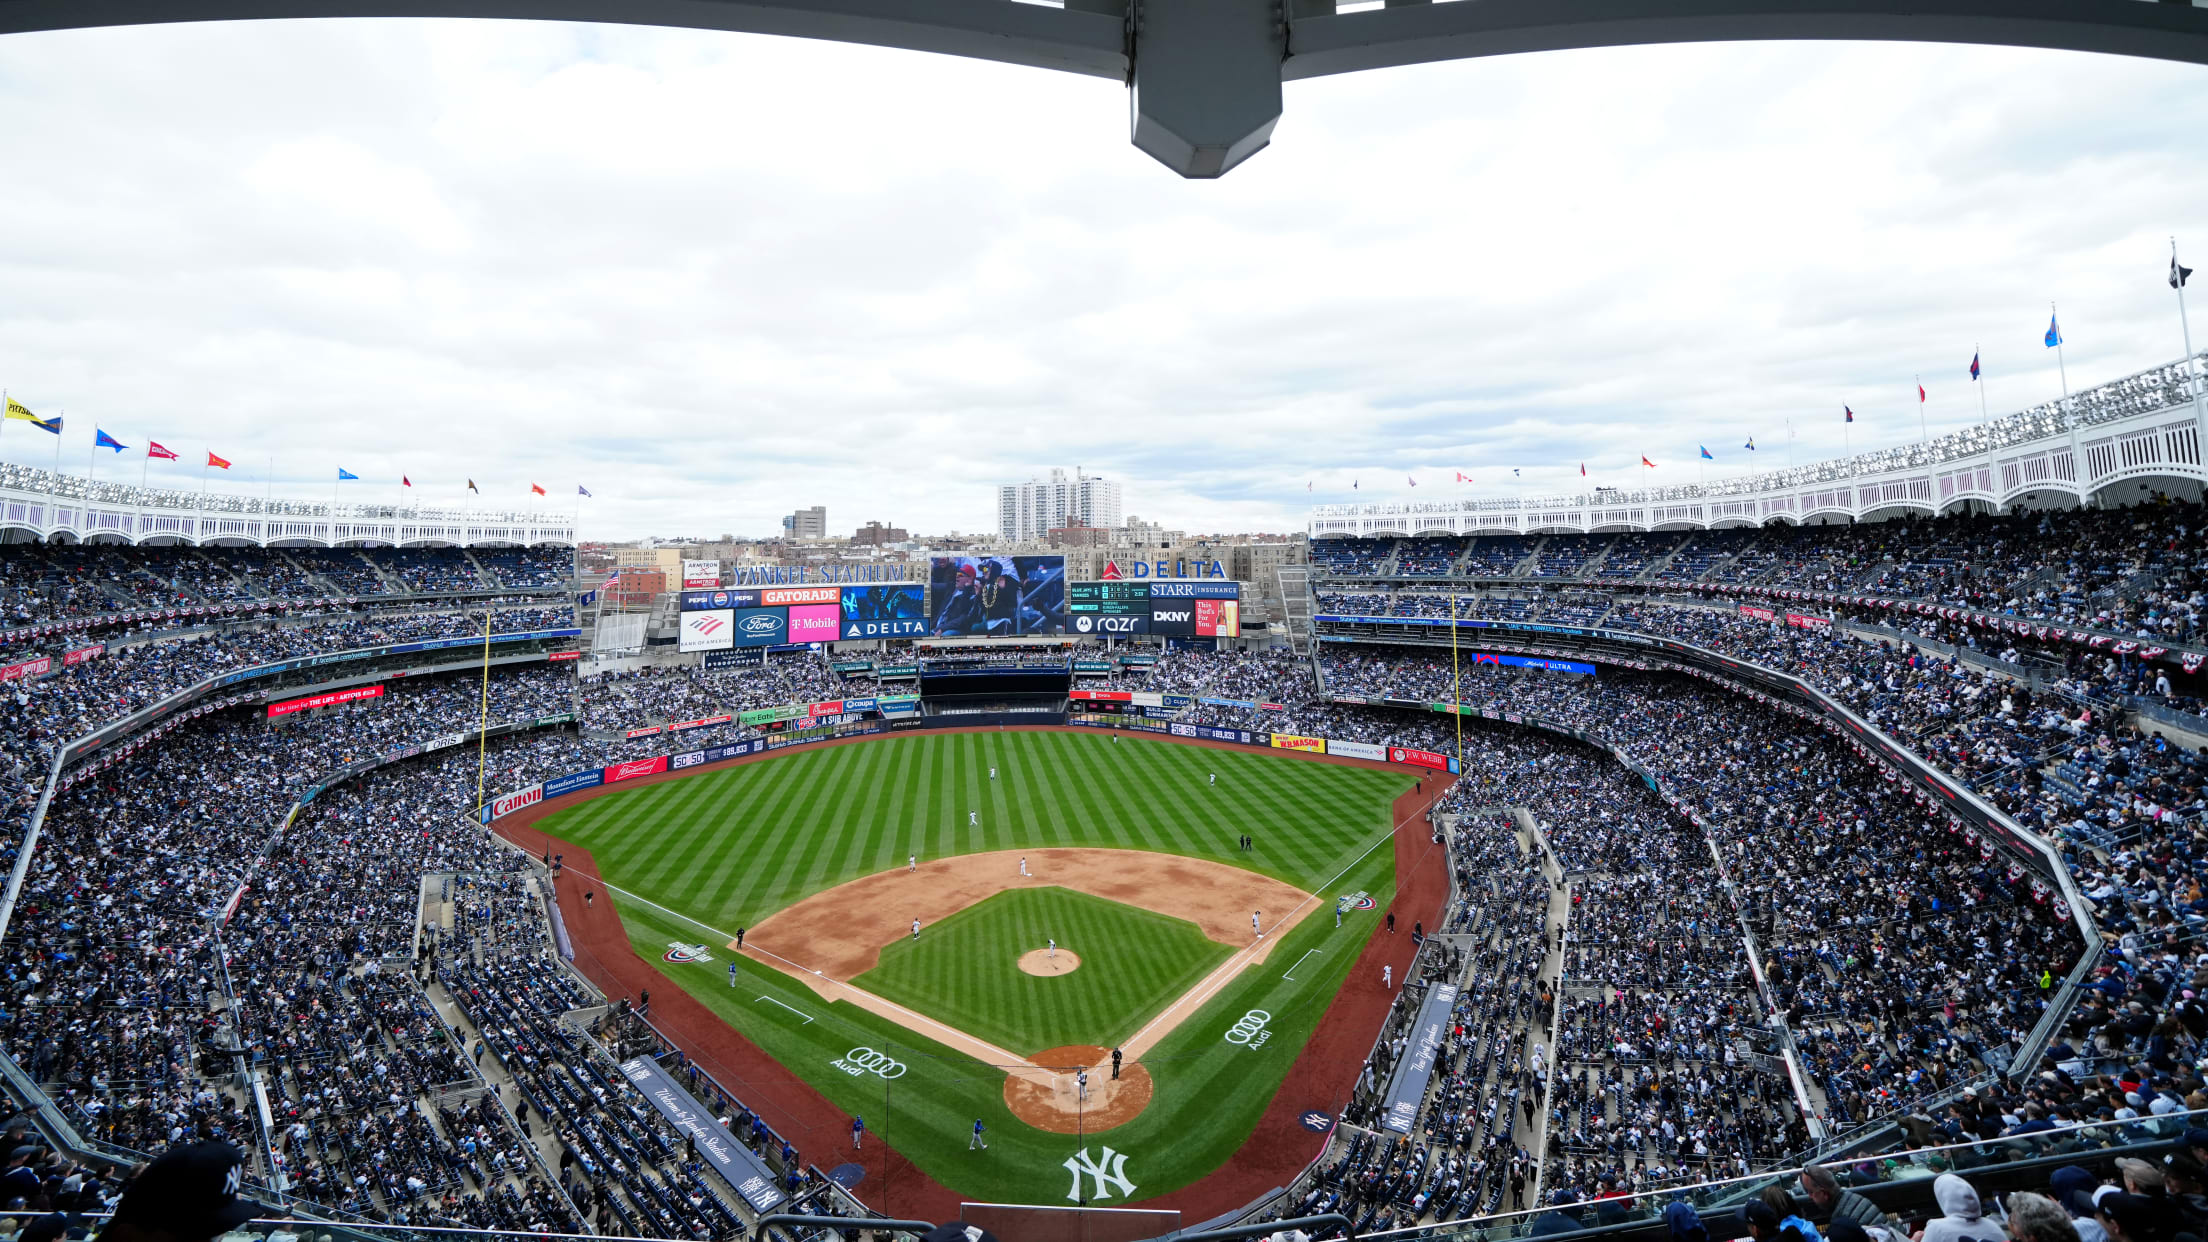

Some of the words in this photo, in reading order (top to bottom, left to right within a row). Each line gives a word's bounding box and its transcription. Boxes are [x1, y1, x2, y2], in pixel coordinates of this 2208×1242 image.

[733, 565, 808, 586] YANKEE
[820, 564, 904, 585] STADIUM
[1134, 561, 1227, 578] DELTA
[766, 590, 836, 602] GATORADE
[1152, 584, 1194, 596] STARR
[1154, 611, 1190, 622] DKNY
[747, 618, 775, 630] Ford
[803, 618, 836, 628] Mobile
[866, 622, 924, 634] DELTA
[1098, 618, 1138, 632] razr
[309, 698, 322, 706] THE
[322, 696, 335, 704] LIFE
[855, 700, 873, 708] coupa
[822, 717, 826, 725] A
[828, 715, 842, 724] SUB
[842, 714, 864, 722] ABOVE
[1173, 725, 1182, 734] 50
[1186, 727, 1194, 736] 50
[434, 737, 457, 749] ORIS
[676, 757, 686, 766] 50
[691, 754, 702, 764] 50
[1406, 752, 1420, 760] F.W.
[1422, 754, 1442, 764] WEBB
[622, 764, 654, 776] Budweiser
[546, 778, 576, 790] Montefiore
[576, 773, 599, 782] Einstein
[494, 788, 541, 816] Canon
[1248, 1030, 1272, 1051] Audi
[830, 1059, 864, 1076] Audi
[654, 1088, 680, 1114] Welcome
[674, 1114, 709, 1138] Yankee
[702, 1136, 732, 1164] Stadium
[1304, 1114, 1330, 1130] NY
[1389, 1116, 1410, 1131] NY
[222, 1162, 243, 1195] NY
[1062, 1145, 1138, 1202] NY
[754, 1190, 779, 1208] NY
